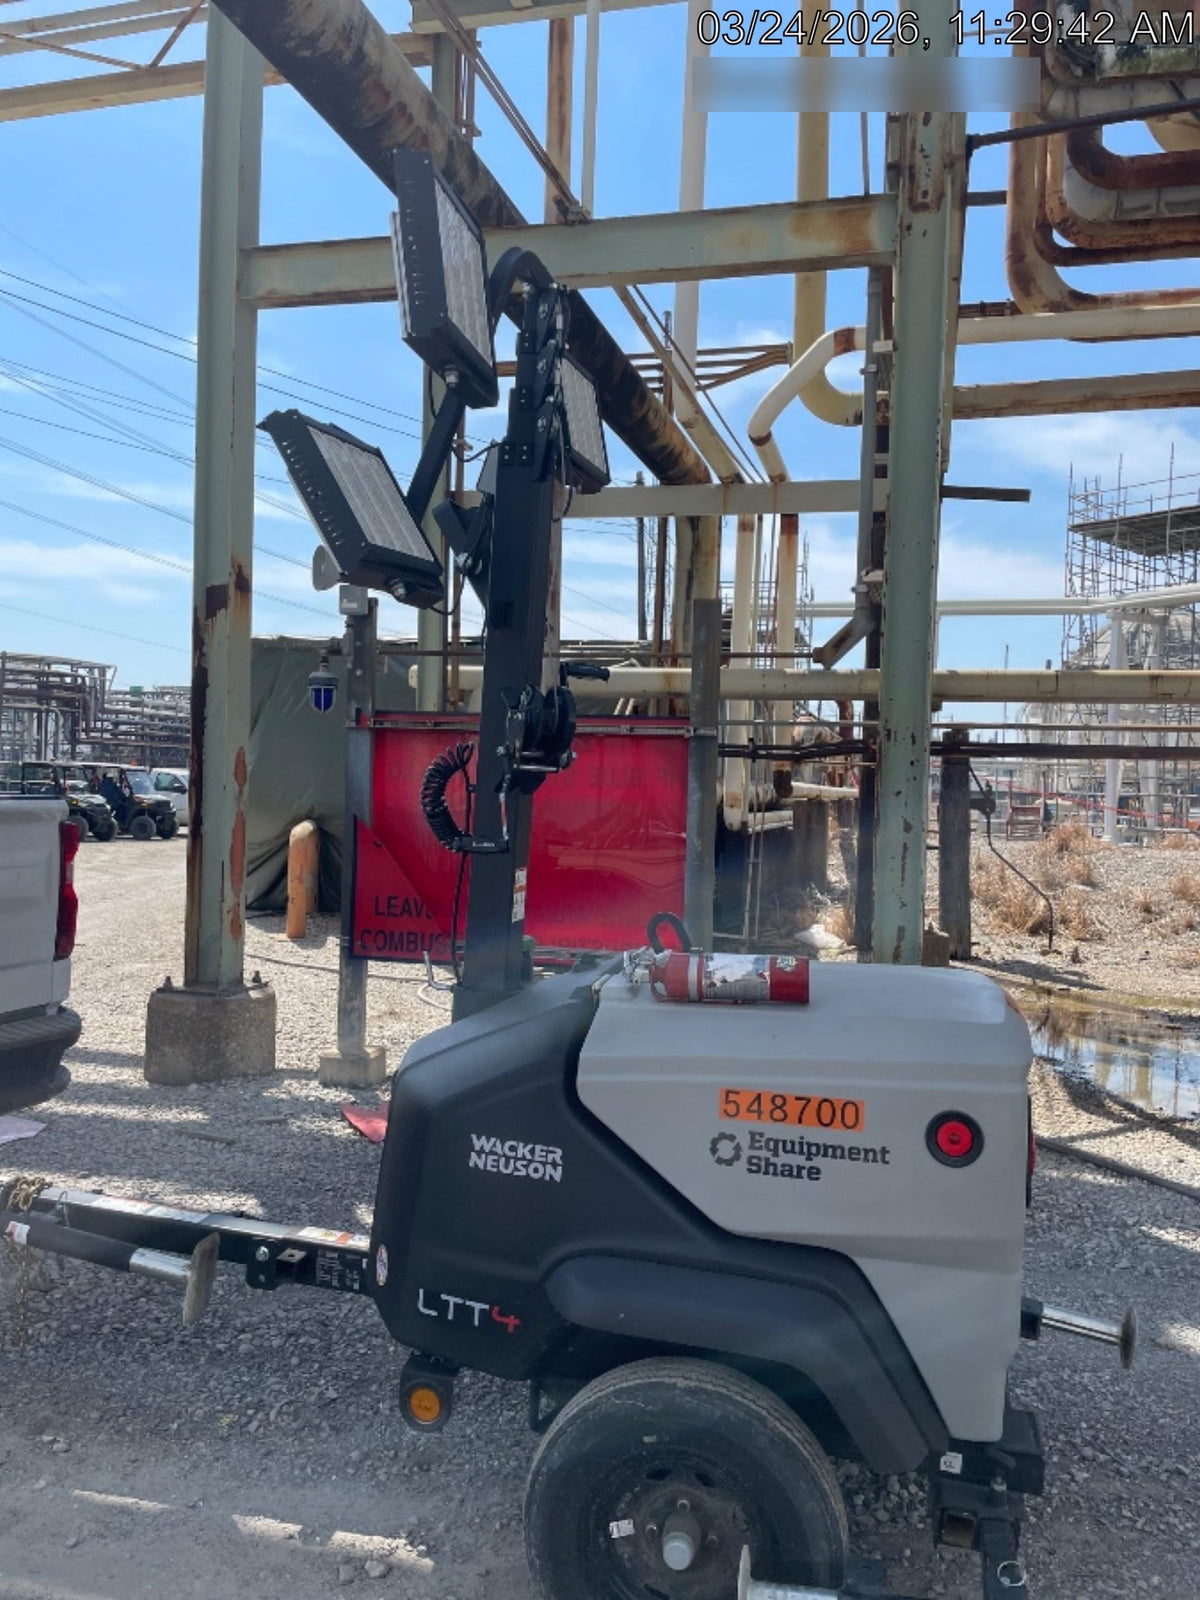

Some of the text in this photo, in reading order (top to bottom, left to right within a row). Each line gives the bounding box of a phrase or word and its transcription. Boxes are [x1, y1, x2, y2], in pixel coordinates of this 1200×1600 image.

[373, 895, 434, 920] LEAV
[722, 1088, 861, 1131] 548700
[470, 1132, 564, 1166] WACKER
[747, 1130, 891, 1165] Equipment
[468, 1151, 563, 1183] NEUSON
[746, 1155, 822, 1182] Share
[416, 1287, 521, 1334] LTT4
